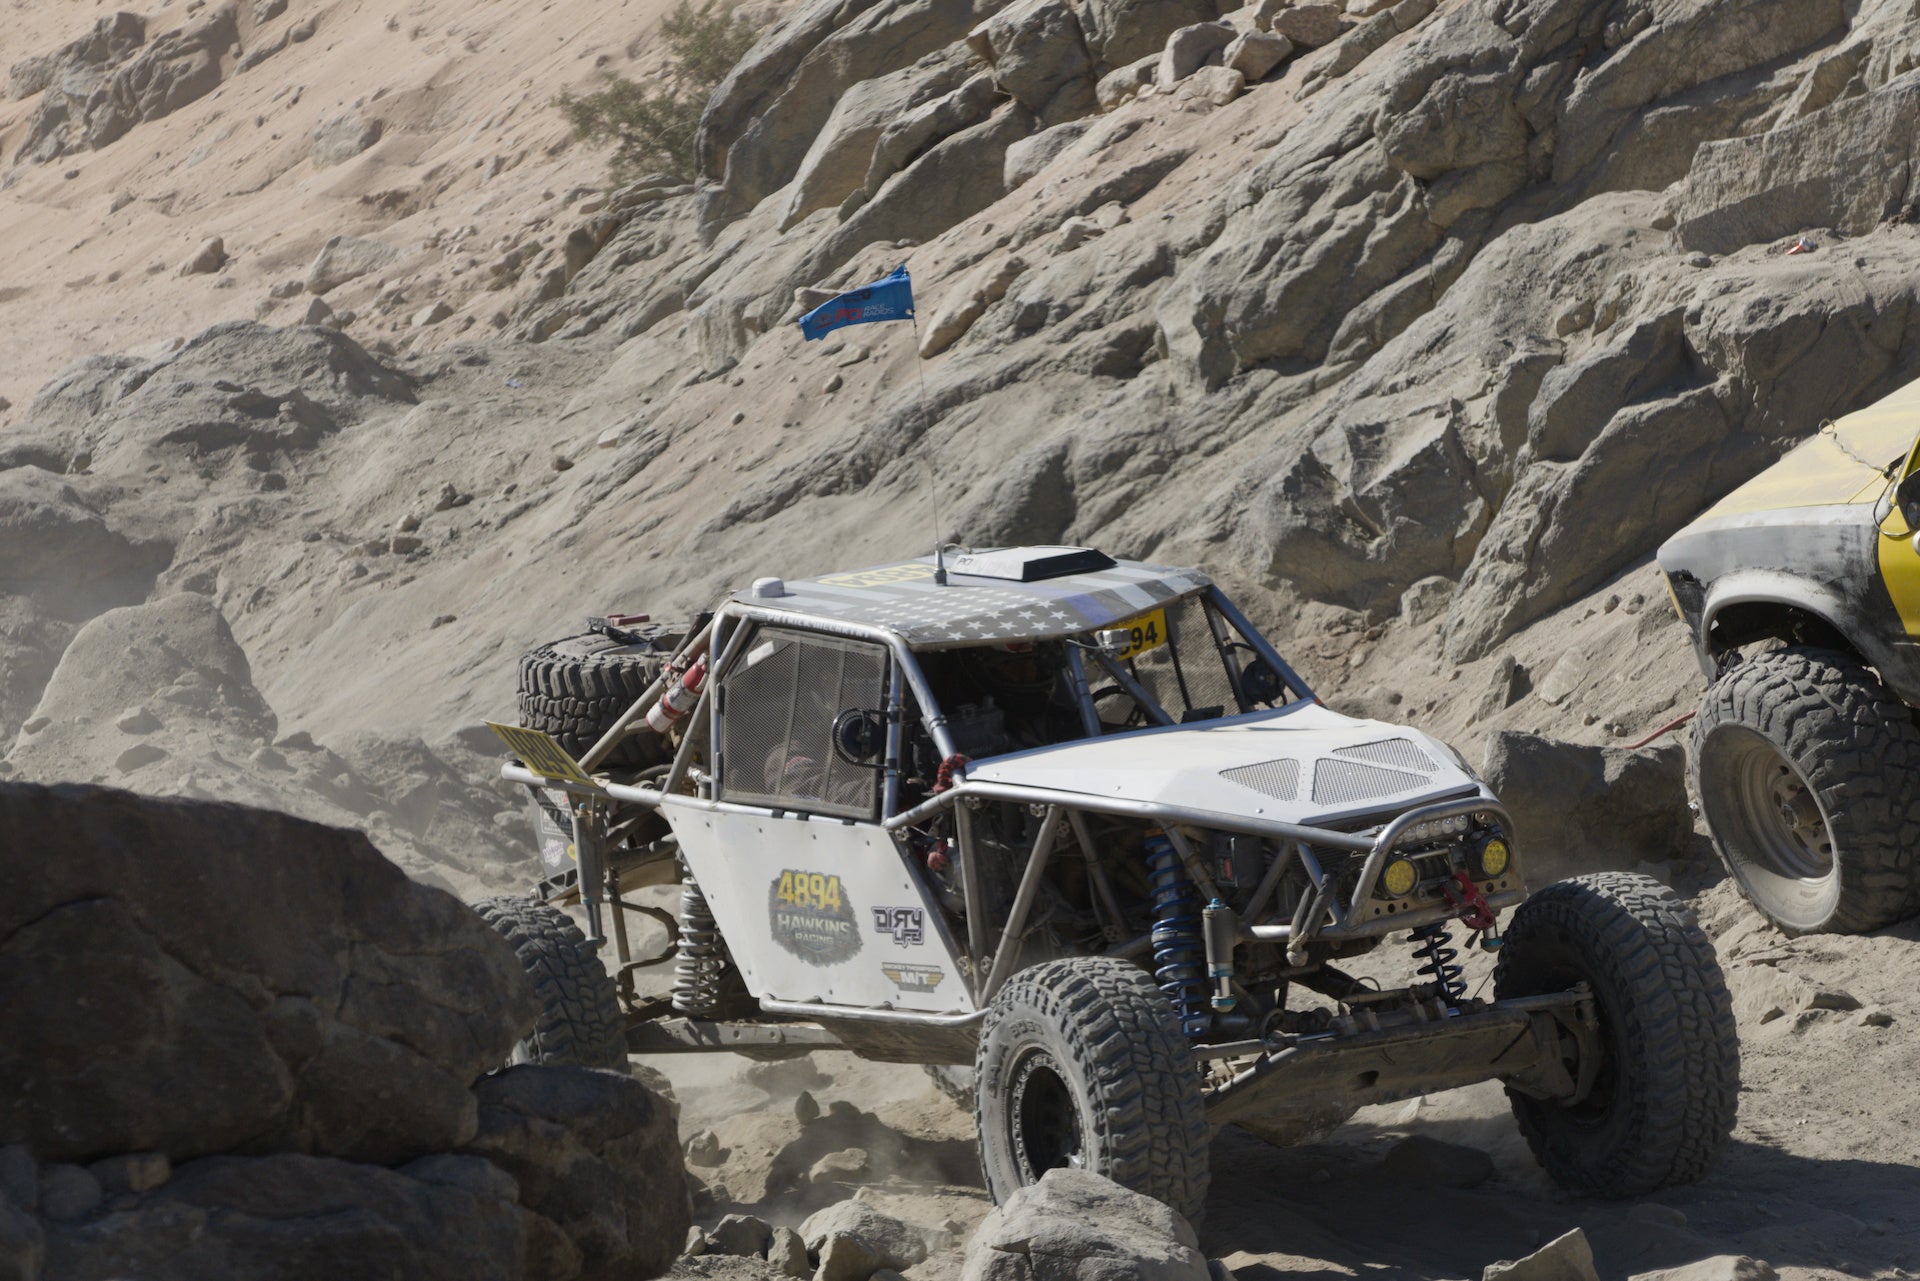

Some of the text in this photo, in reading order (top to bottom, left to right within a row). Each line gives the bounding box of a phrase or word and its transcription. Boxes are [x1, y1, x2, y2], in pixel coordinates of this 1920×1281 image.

[835, 307, 863, 322] PCI
[776, 871, 842, 912] 4894
[777, 913, 850, 936] HAWKINS
[873, 908, 922, 929] DIRTY
[795, 932, 834, 945] RACING
